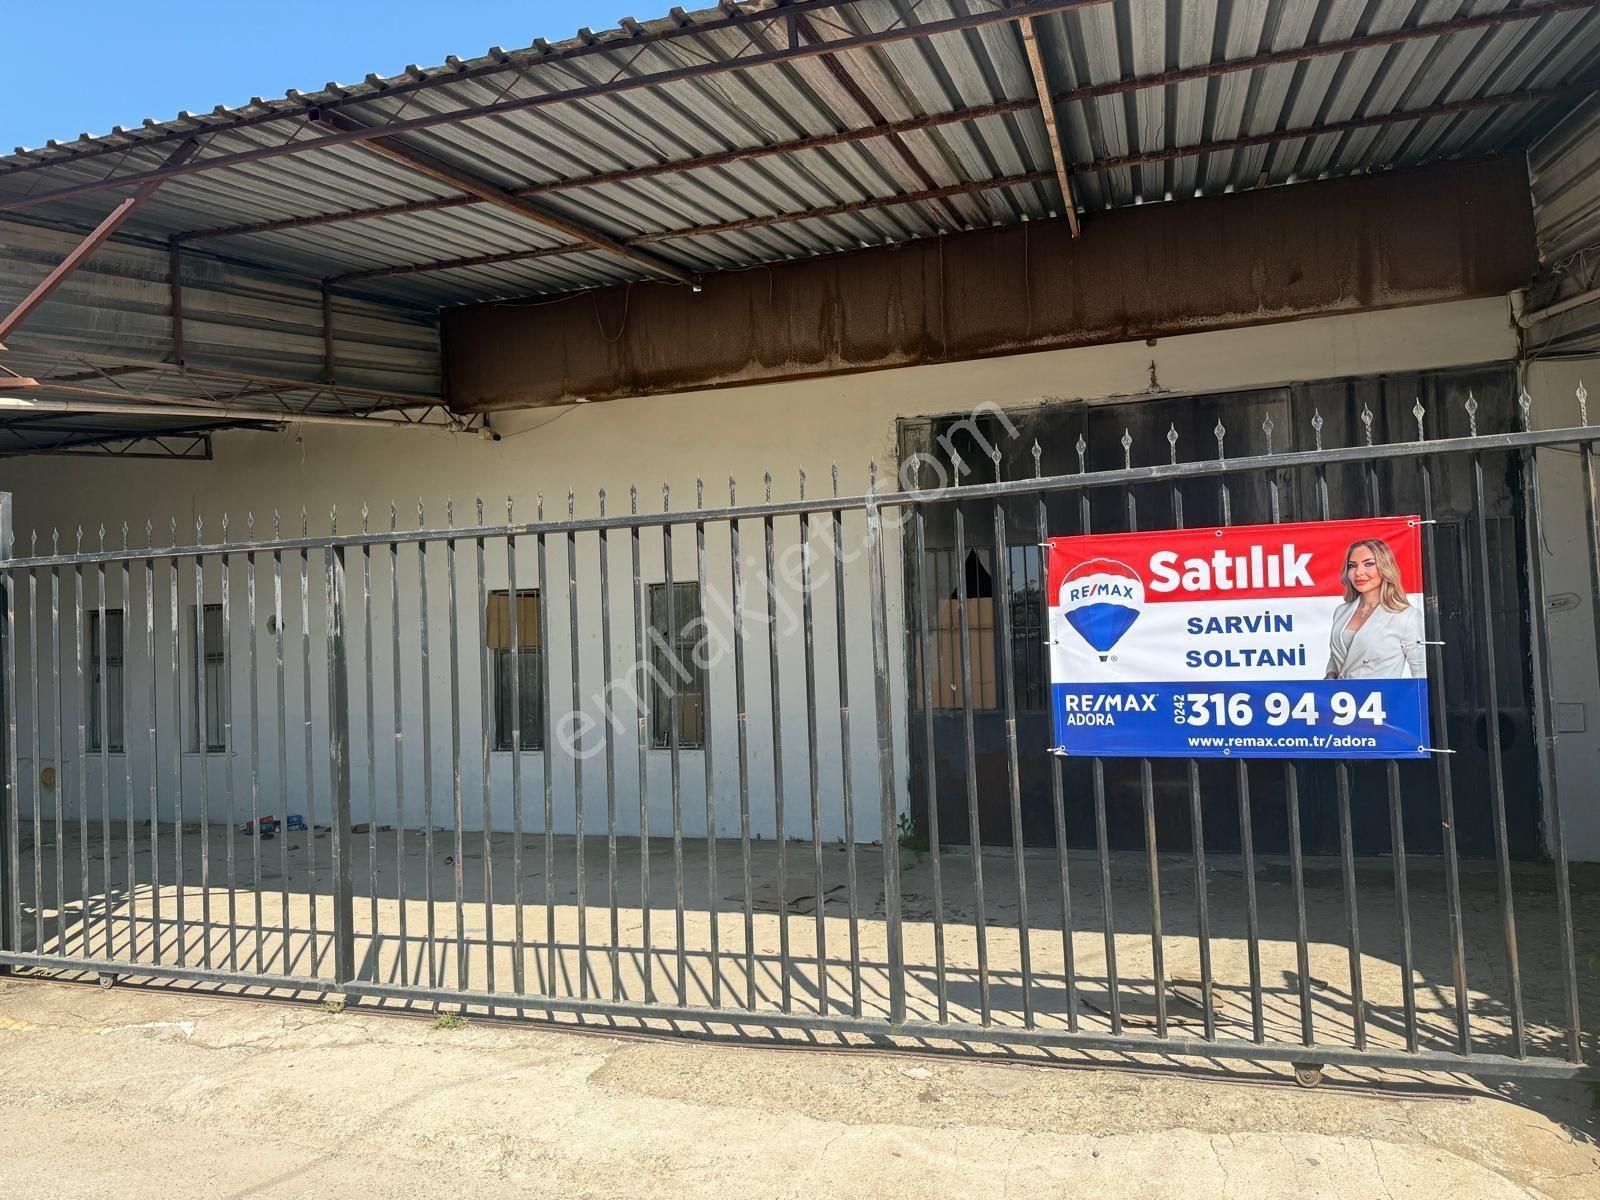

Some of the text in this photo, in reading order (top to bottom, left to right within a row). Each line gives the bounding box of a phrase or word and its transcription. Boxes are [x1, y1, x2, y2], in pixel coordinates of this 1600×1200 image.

[1149, 543, 1315, 592] Satılık
[1070, 582, 1133, 602] RE/MAX
[1187, 611, 1293, 635] SARVİN
[1185, 643, 1306, 668] SOLTANİ
[1065, 693, 1157, 712] RE/MAX
[1174, 691, 1386, 726] 0242 316 94 94
[1067, 713, 1115, 726] ADORA
[1188, 735, 1376, 747] www.remax.com.tr/adora
